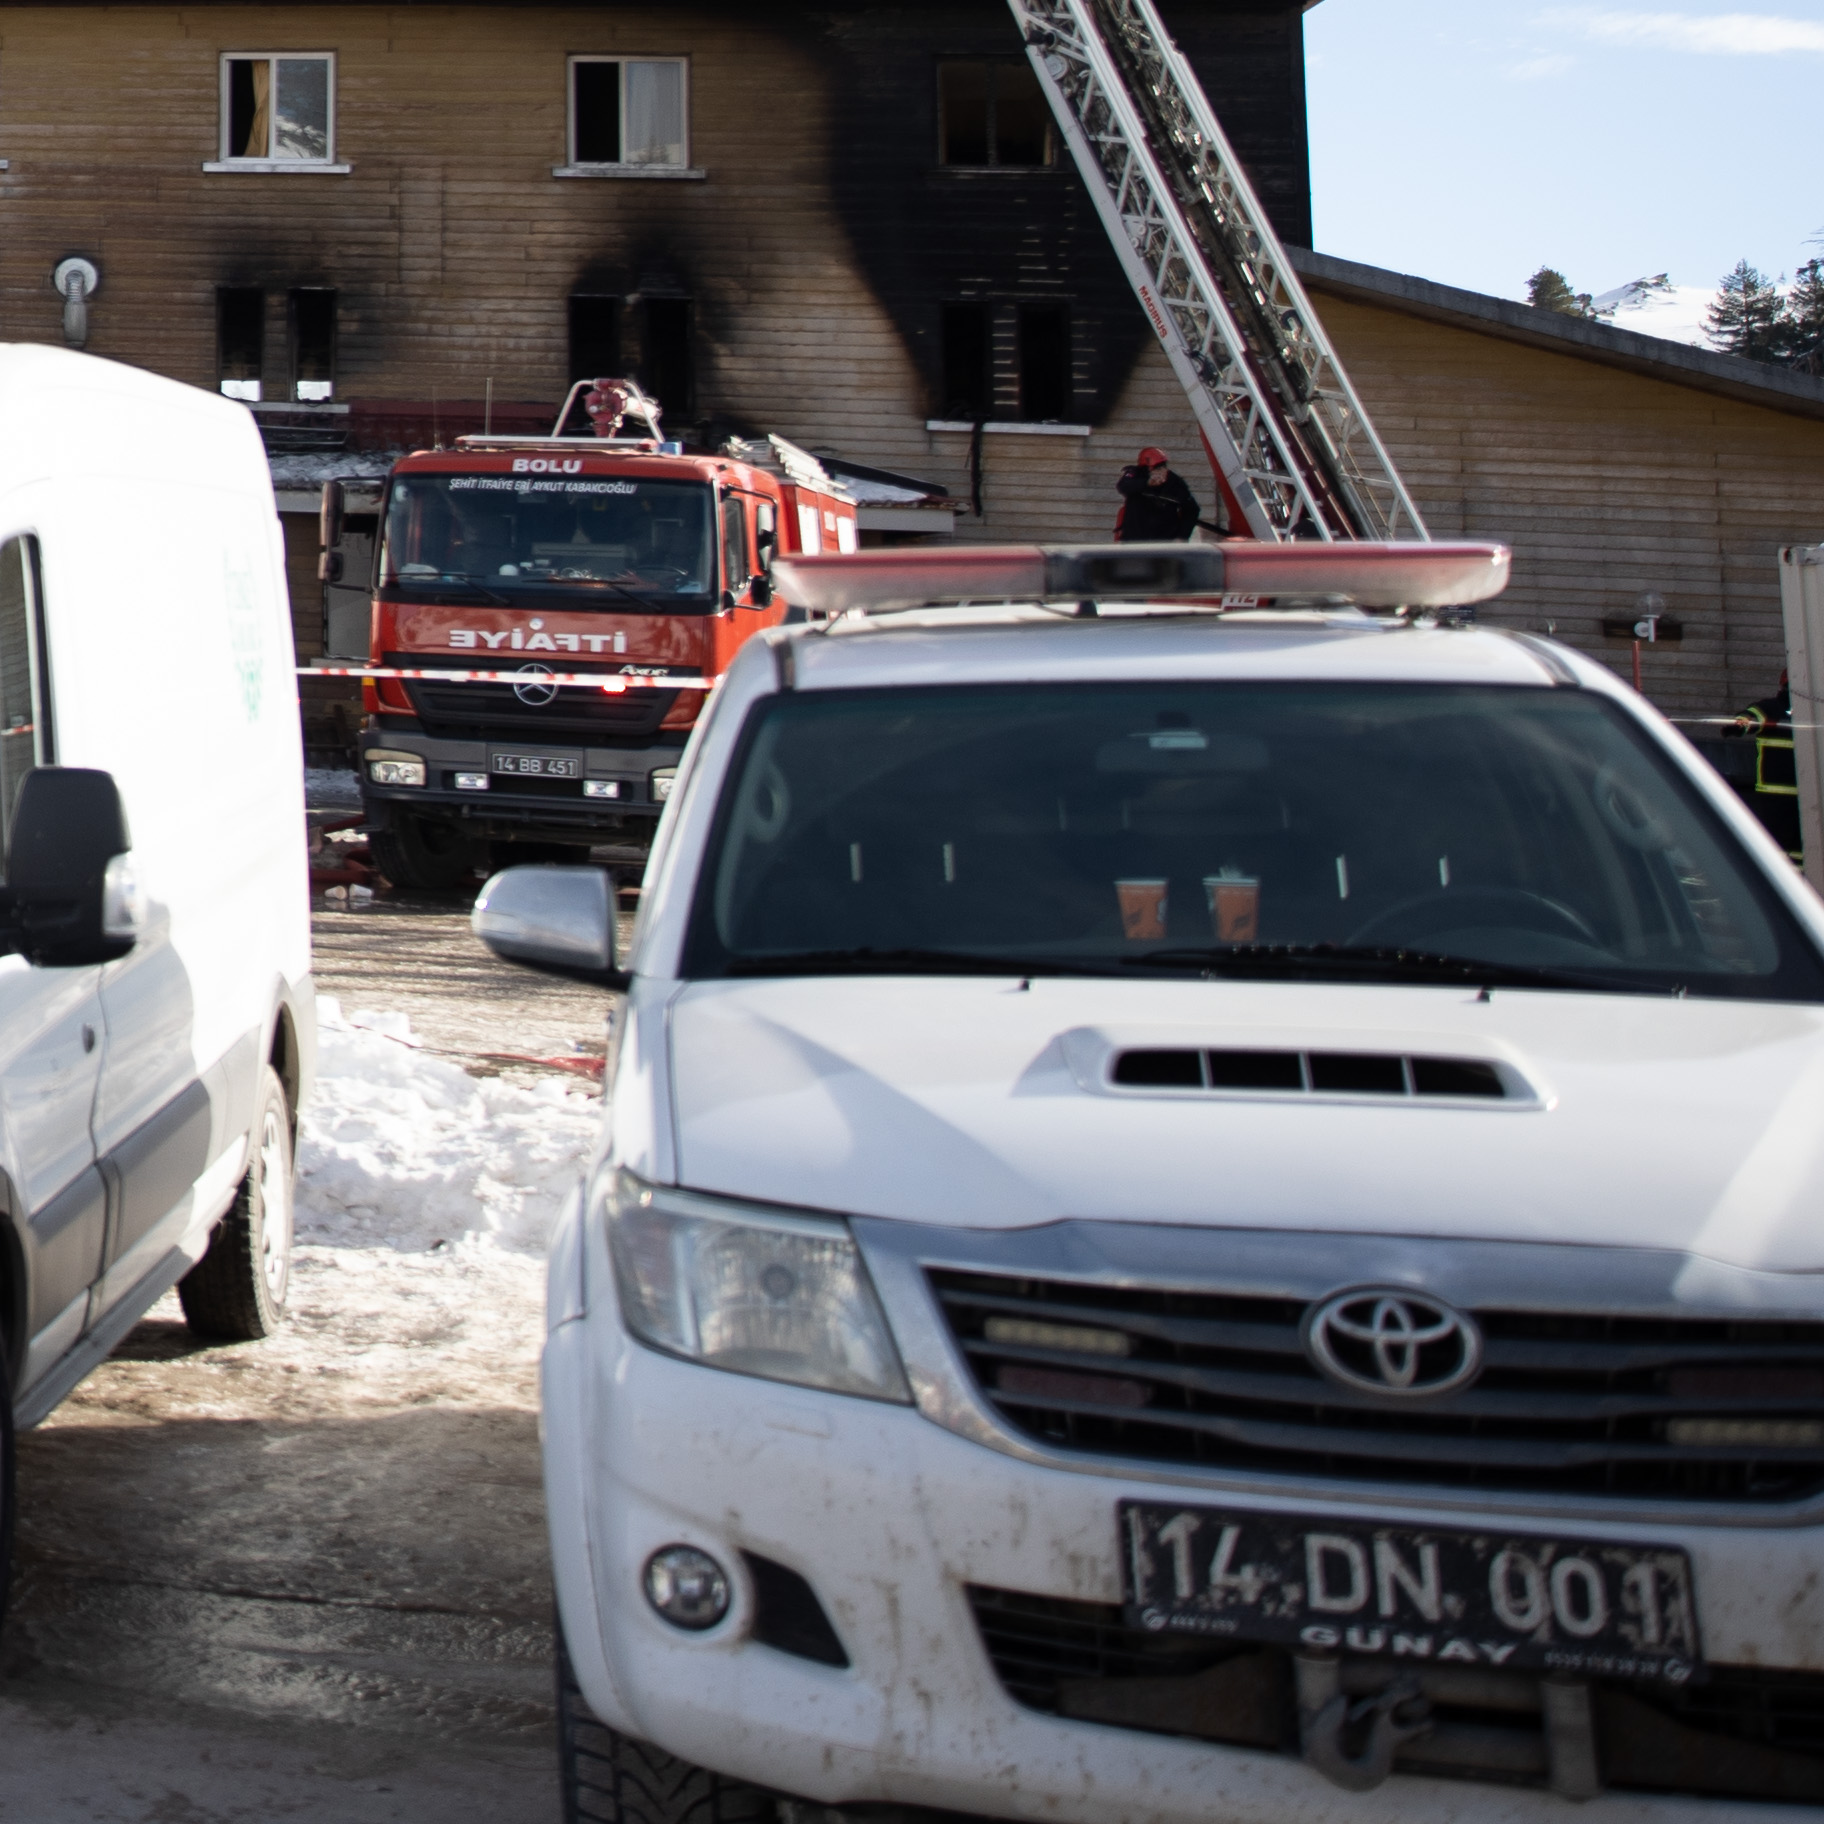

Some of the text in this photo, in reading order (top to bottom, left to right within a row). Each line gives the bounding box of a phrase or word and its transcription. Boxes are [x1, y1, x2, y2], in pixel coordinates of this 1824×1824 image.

[512, 459, 582, 474] BOLU
[495, 756, 576, 776] 14 BB 451
[1156, 1511, 1664, 1644] 14 DN 001
